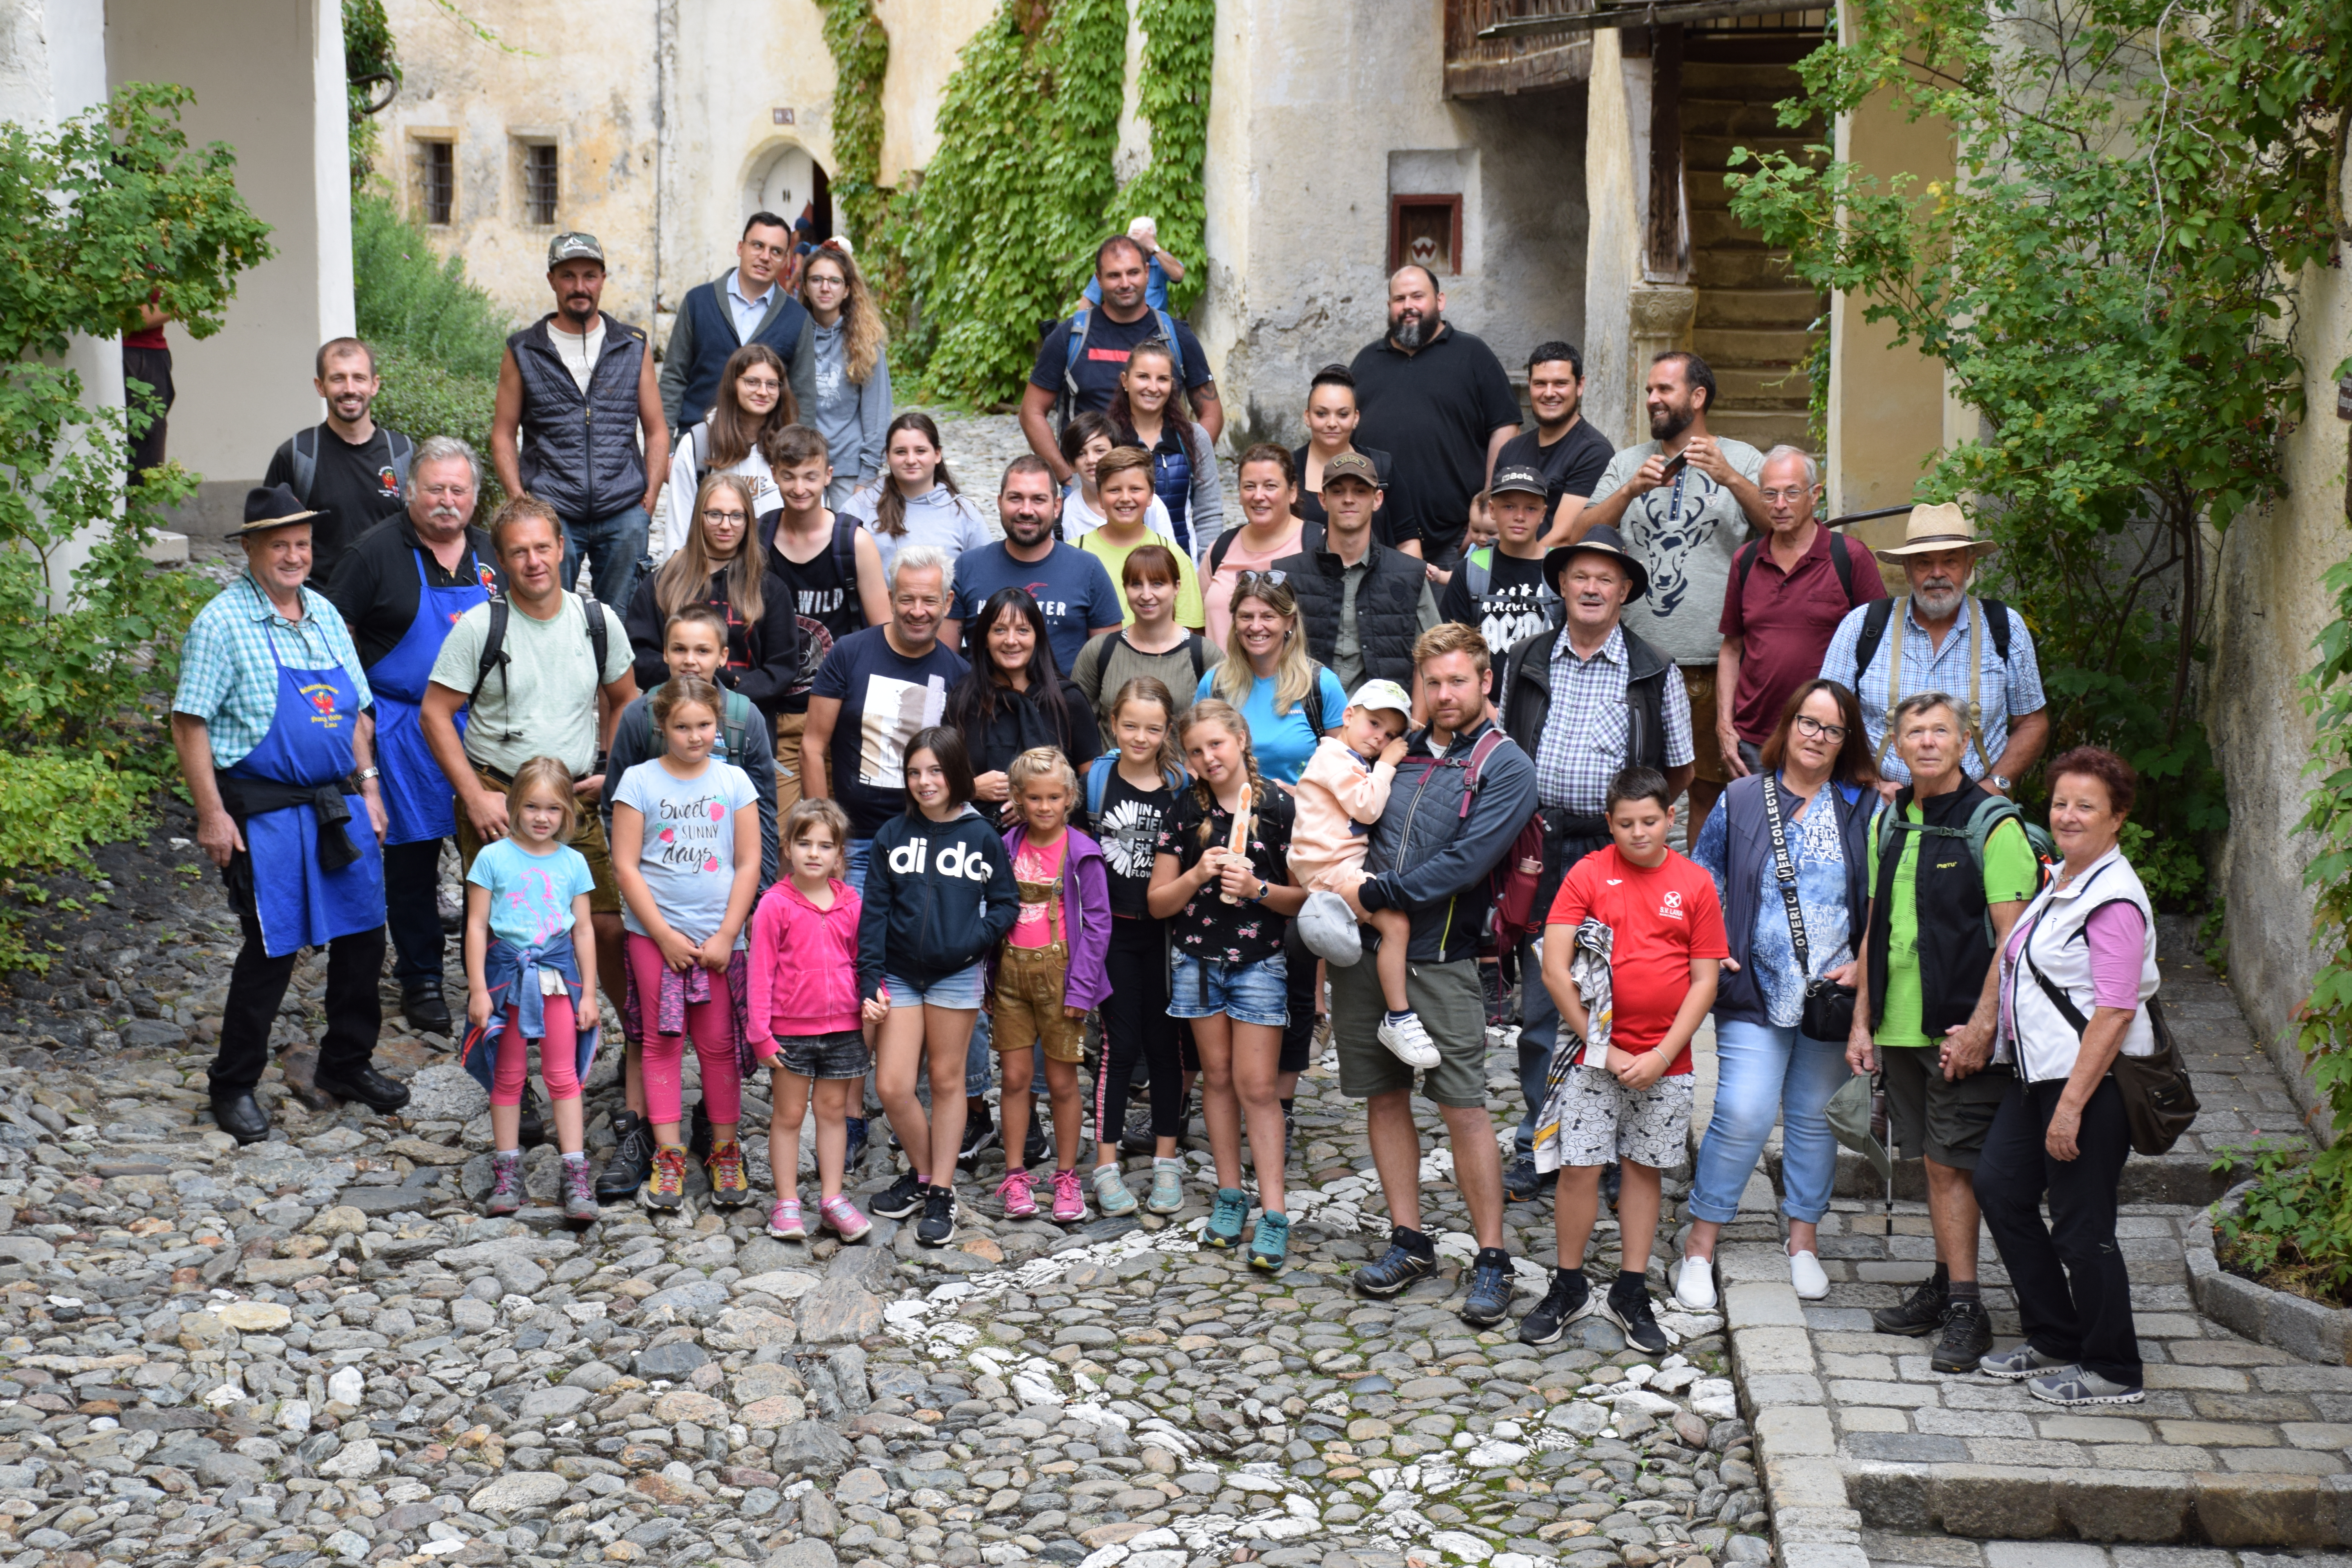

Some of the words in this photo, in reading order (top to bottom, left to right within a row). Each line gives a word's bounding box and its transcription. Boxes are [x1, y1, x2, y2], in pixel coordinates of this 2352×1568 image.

[1510, 472, 1534, 481] Beta
[660, 795, 716, 819] Sweet
[1138, 803, 1153, 816] IN
[1154, 809, 1162, 818] a
[1764, 776, 1784, 846] COLLECTION
[682, 825, 718, 840] SUNNY
[662, 840, 712, 874] days
[1670, 908, 1683, 917] LANA
